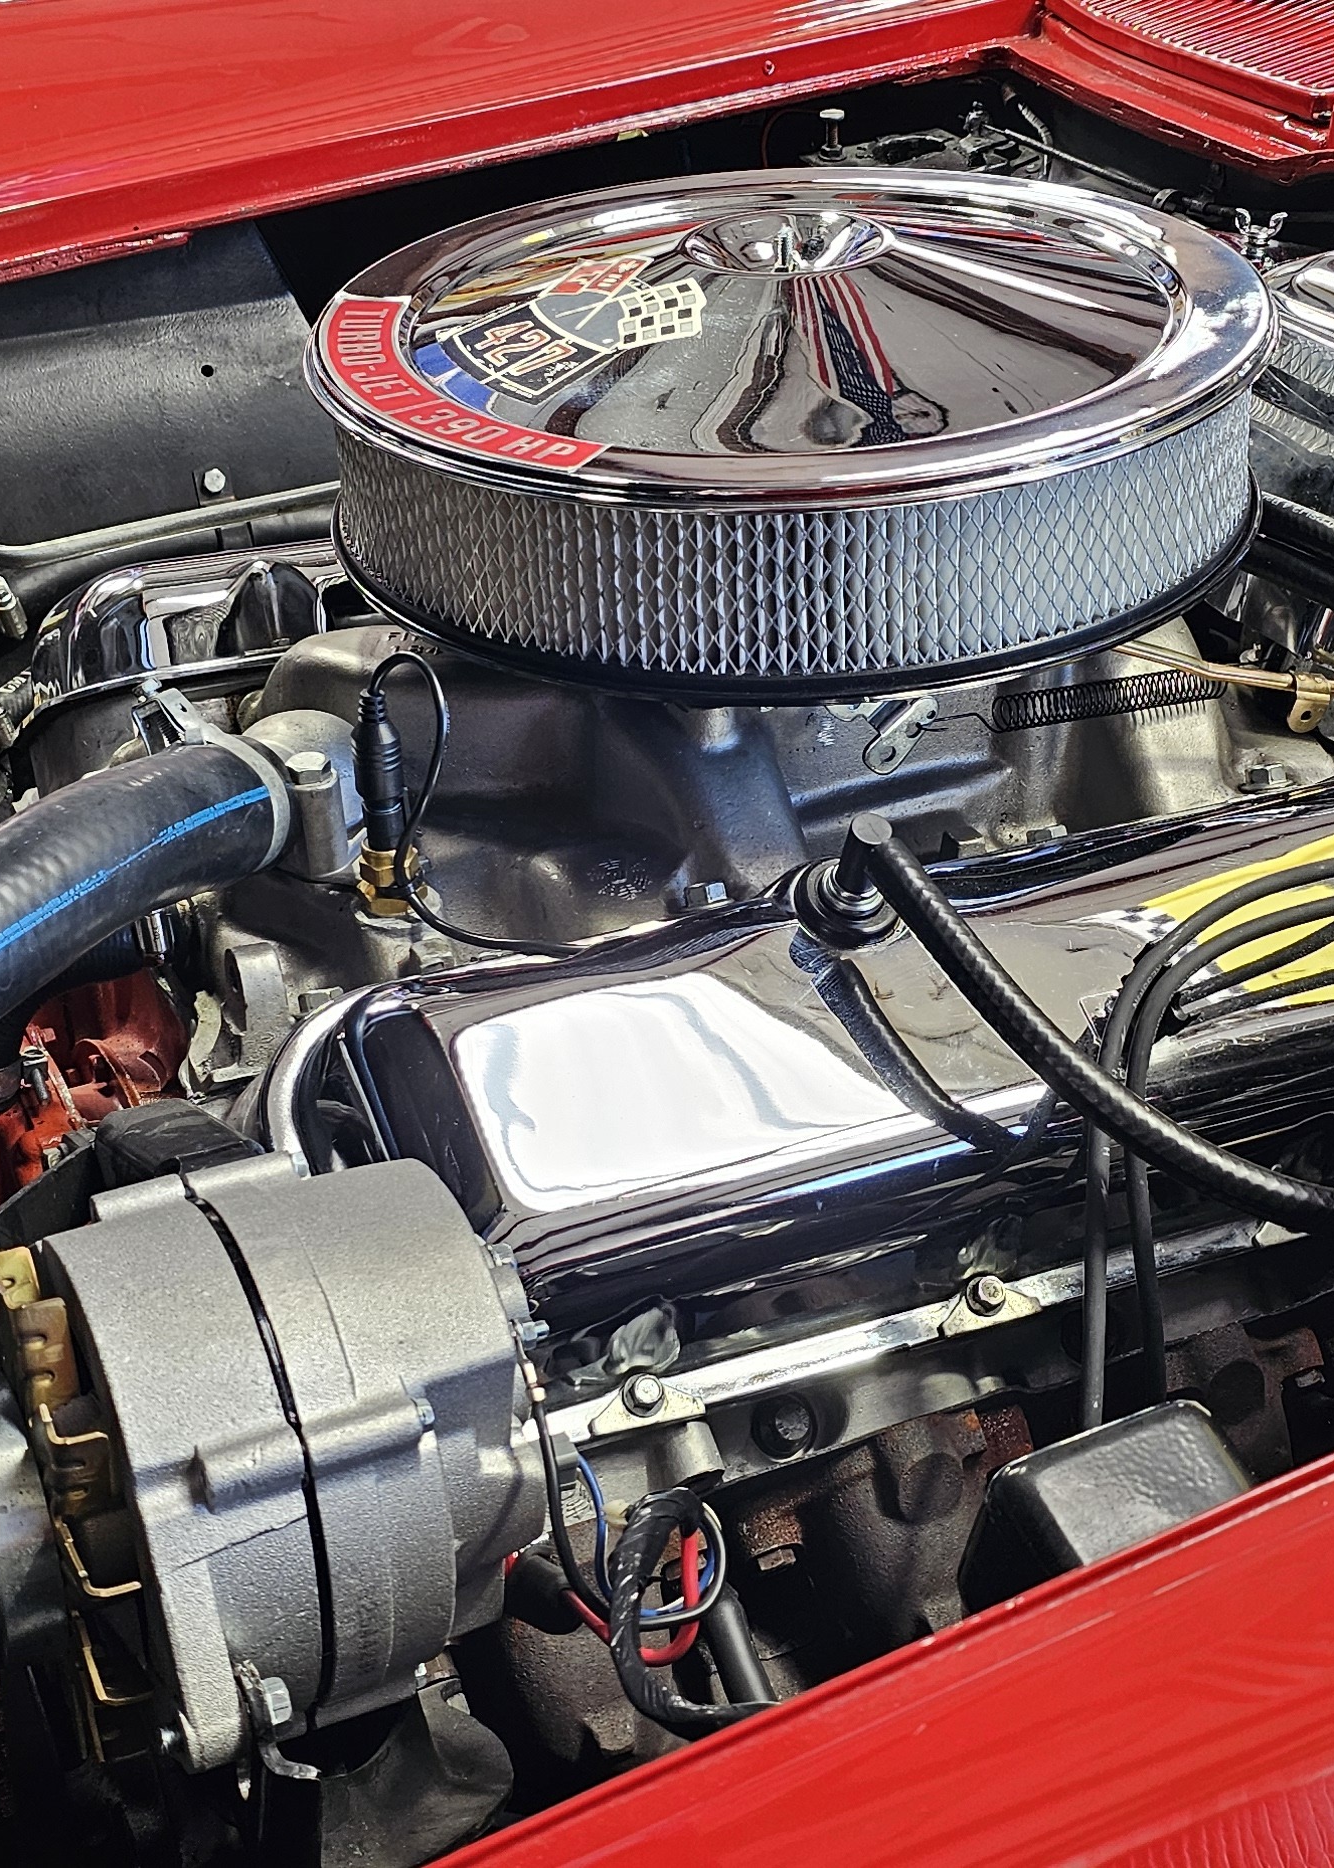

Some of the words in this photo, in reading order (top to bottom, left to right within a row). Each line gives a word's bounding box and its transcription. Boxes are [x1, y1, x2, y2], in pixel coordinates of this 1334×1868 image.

[338, 308, 422, 411] TURBO-JET
[410, 407, 509, 442] 390
[499, 436, 578, 461] HP
[474, 321, 578, 377] 427
